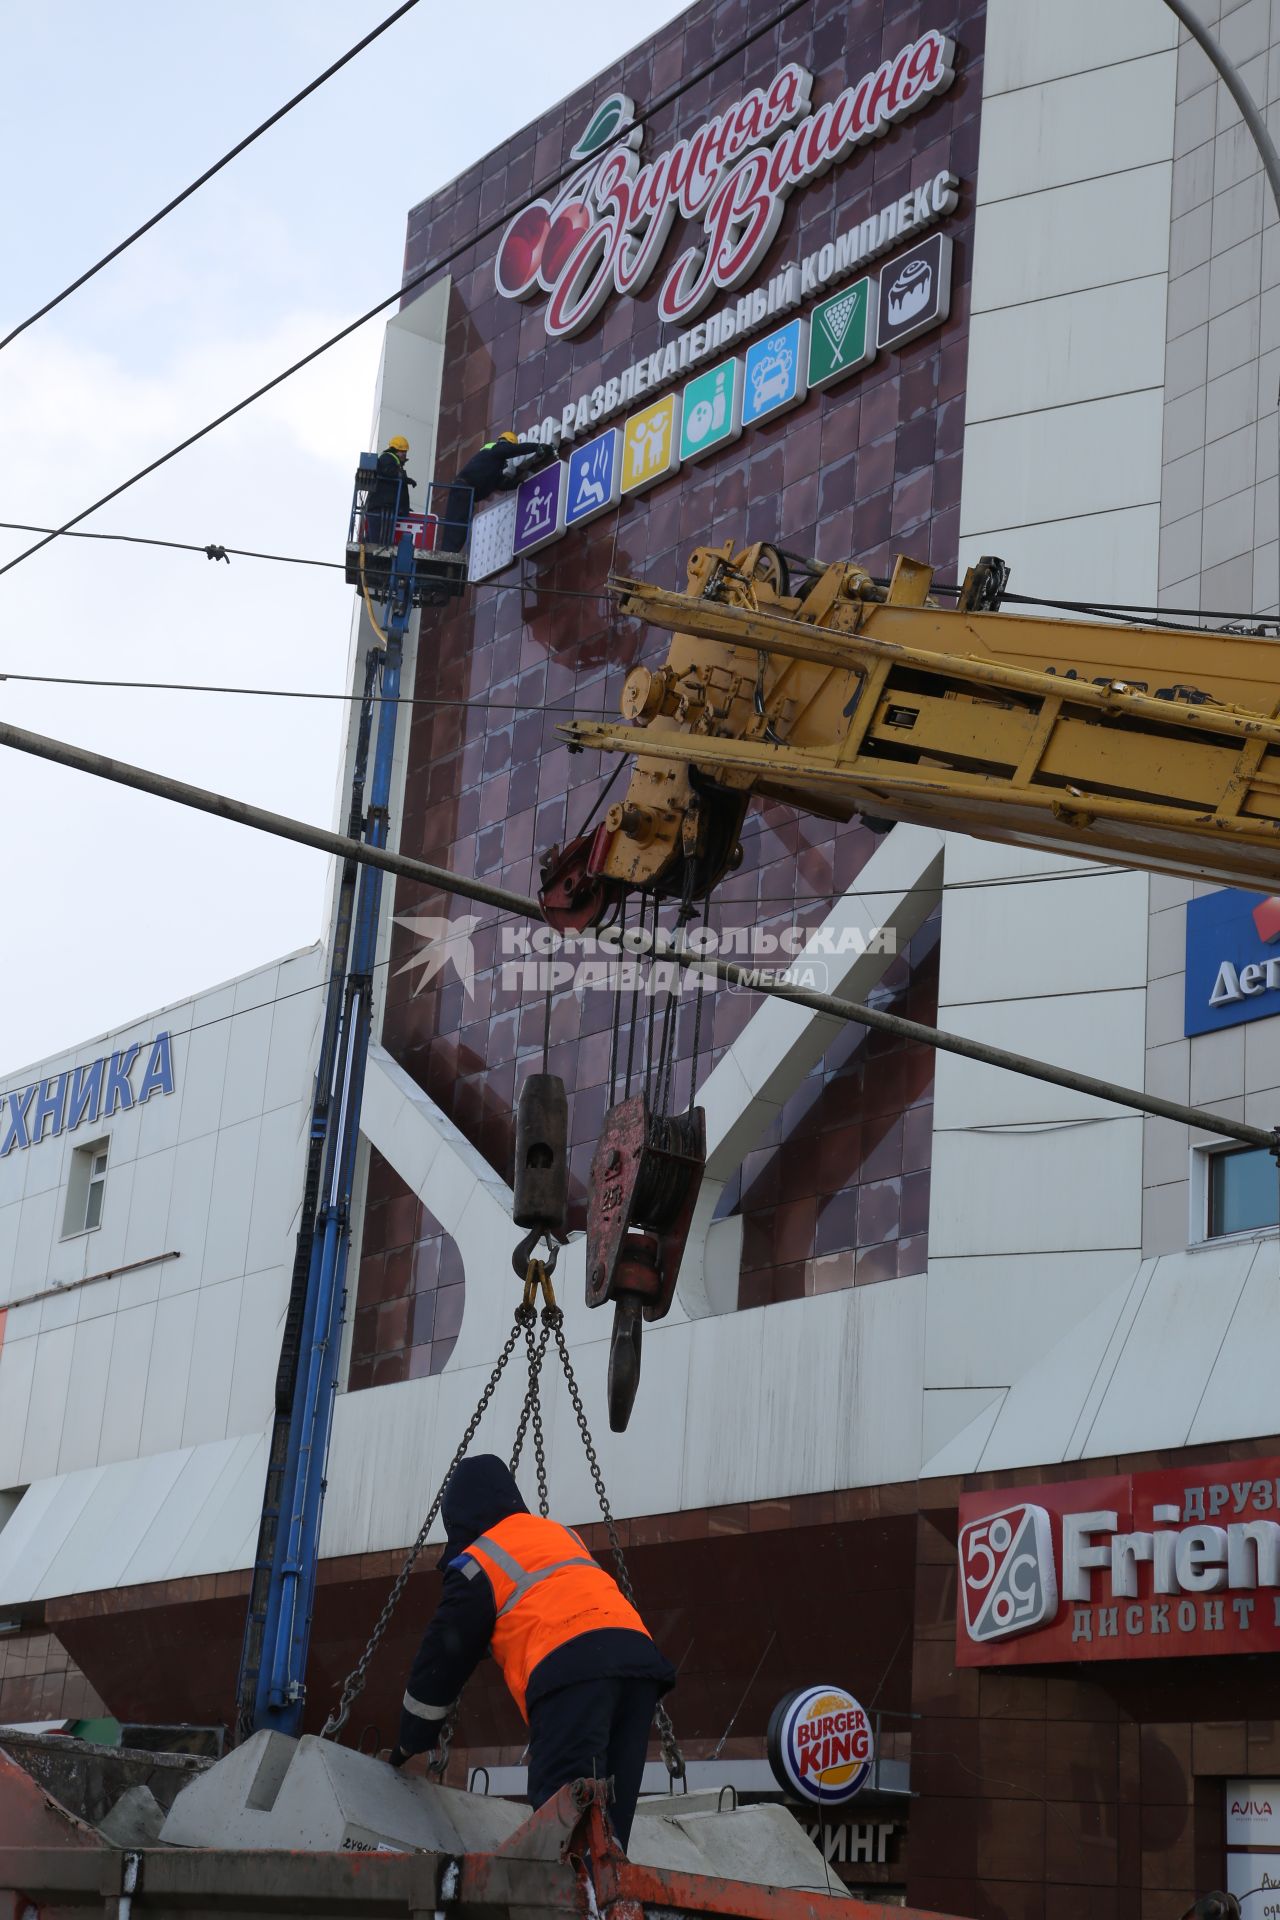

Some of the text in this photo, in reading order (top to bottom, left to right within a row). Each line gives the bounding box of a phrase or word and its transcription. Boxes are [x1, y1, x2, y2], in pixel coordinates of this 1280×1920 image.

[546, 63, 808, 335] Зимняя
[660, 30, 949, 321] Вишня
[802, 170, 957, 293] КОМПЛЕКС
[0, 1031, 175, 1158] ХНИКА
[1183, 1478, 1280, 1522] ДРУЗ
[1062, 1504, 1280, 1602] Frien
[1071, 1598, 1255, 1643] ДИСКОНТ
[797, 1710, 866, 1748] BURGER
[800, 1730, 869, 1777] KING
